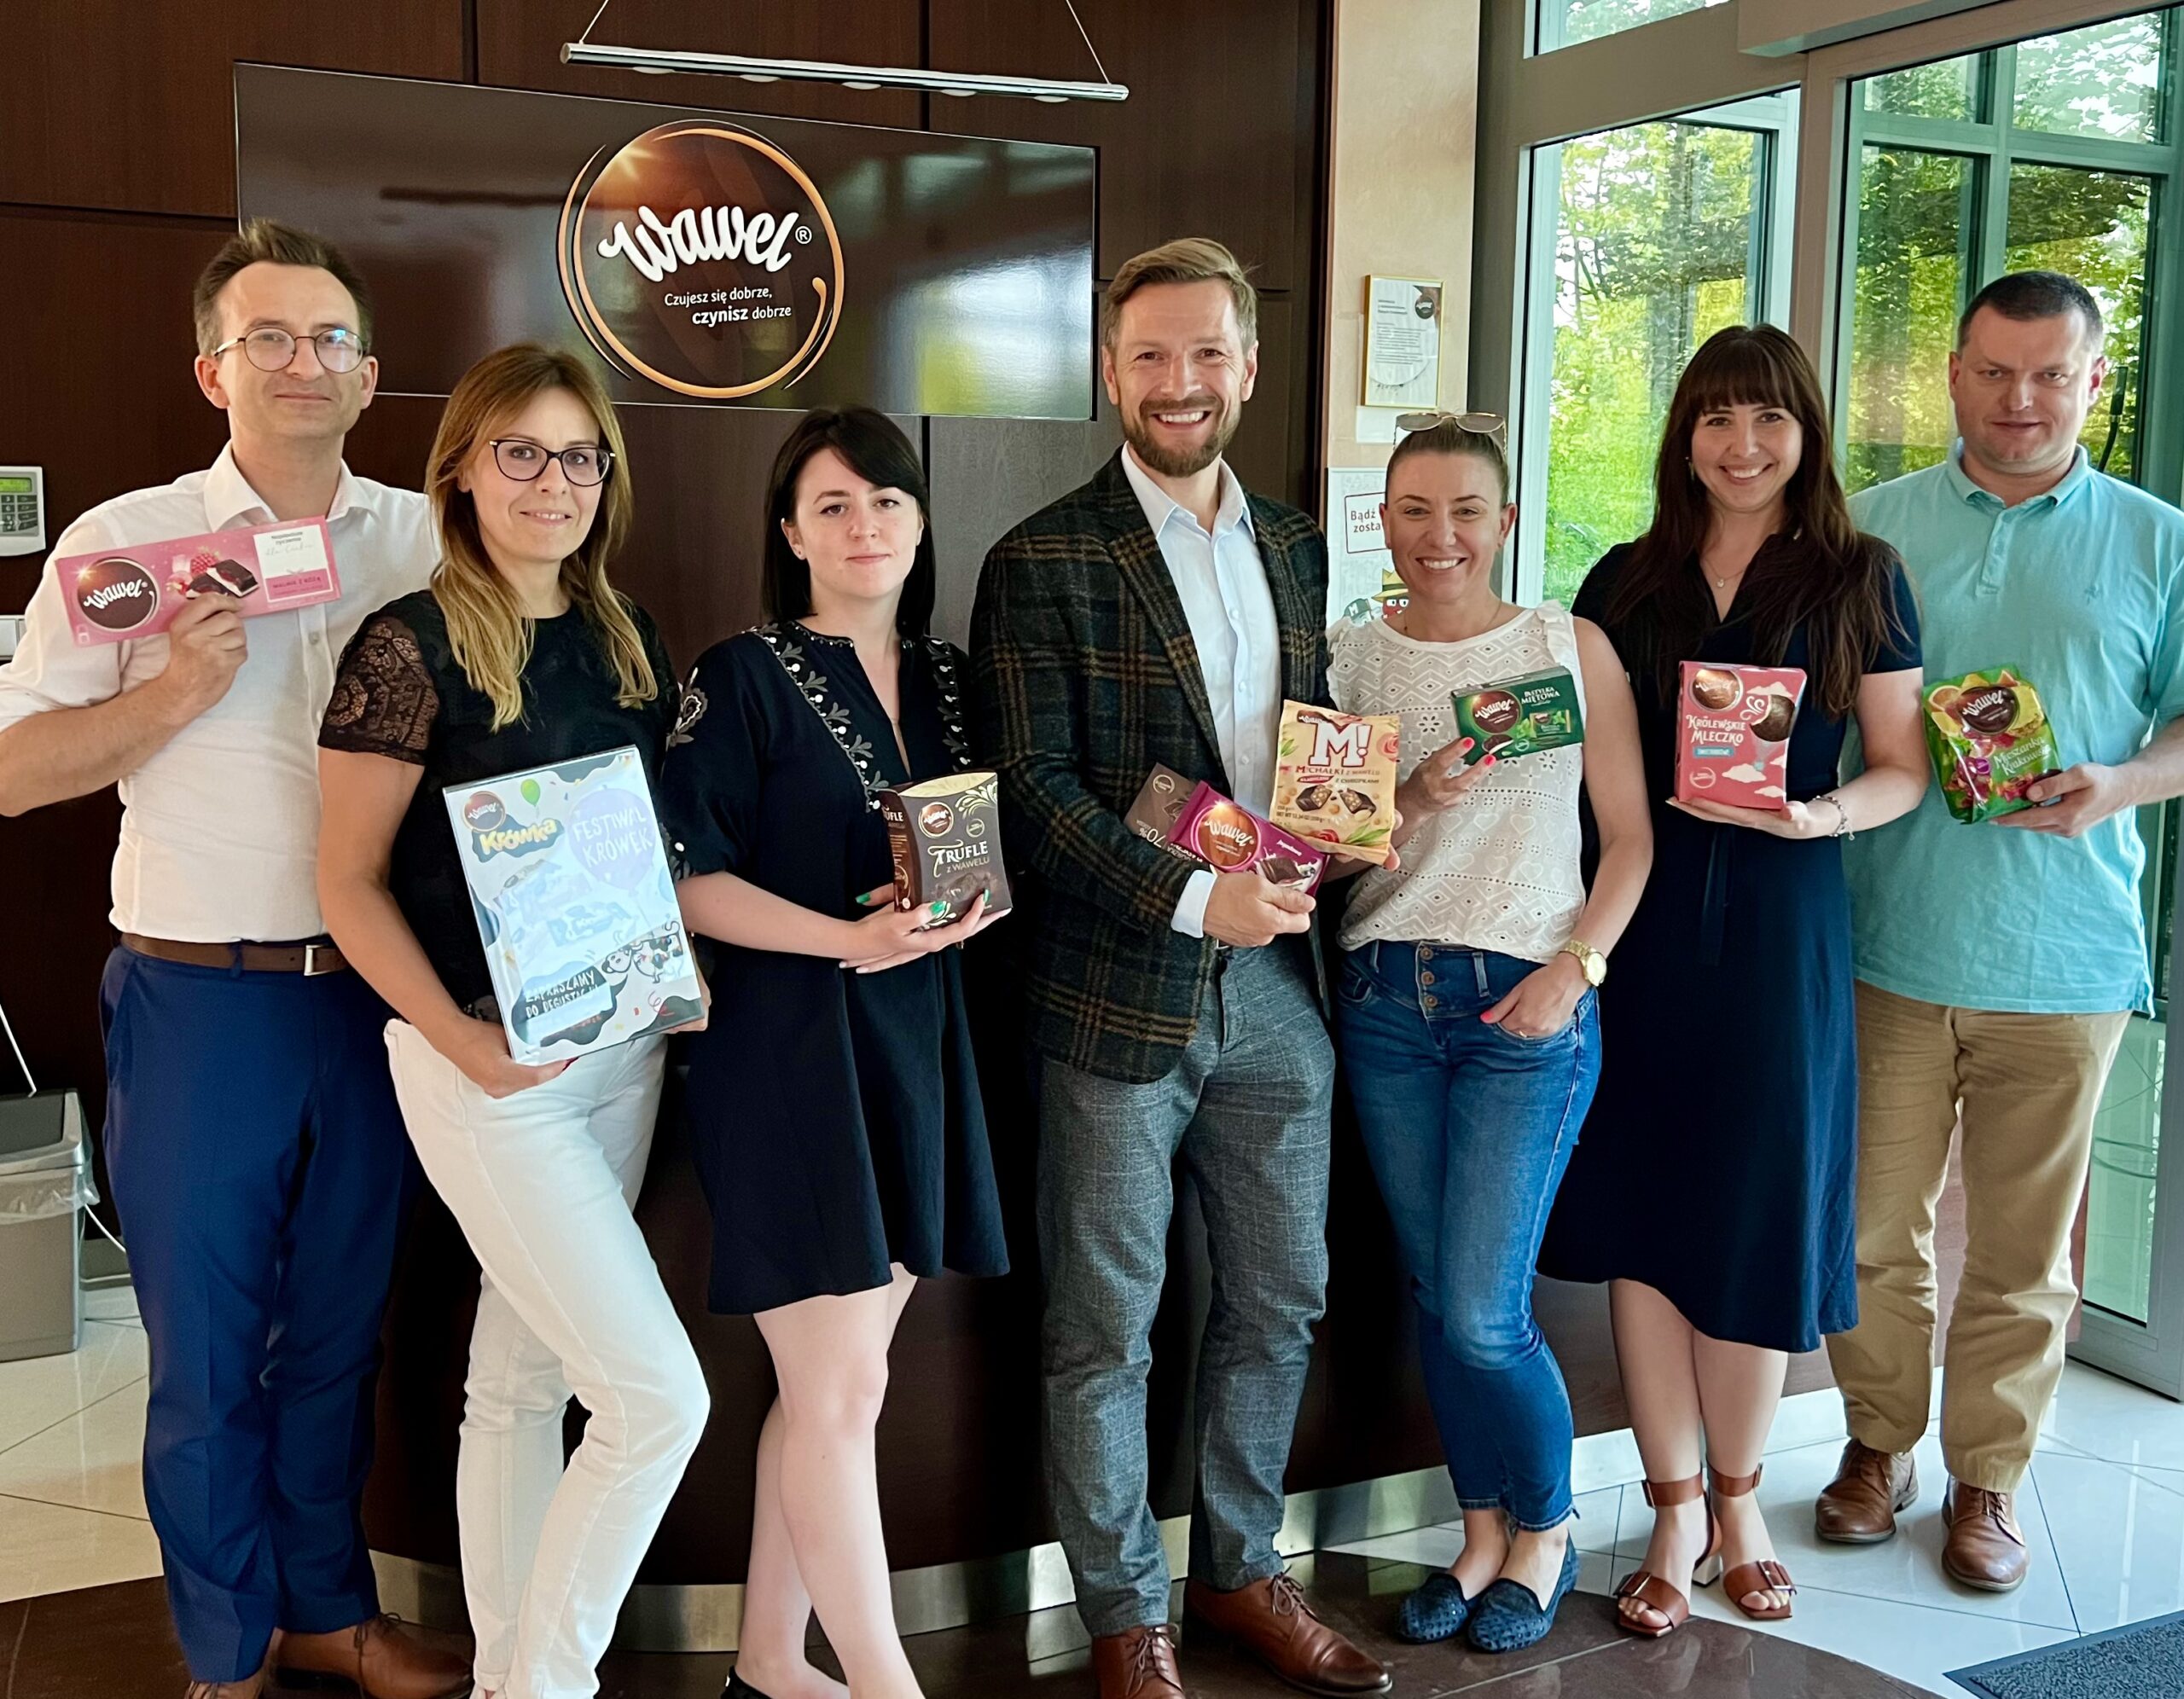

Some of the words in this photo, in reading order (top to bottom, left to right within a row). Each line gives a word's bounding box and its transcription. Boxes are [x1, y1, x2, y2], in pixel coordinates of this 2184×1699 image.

[597, 206, 799, 281] Wawel
[665, 292, 709, 308] Czujesz
[711, 288, 726, 304] się
[729, 286, 773, 300] dobrze,
[692, 305, 749, 328] czynisz
[752, 305, 793, 319] dobrze
[1353, 521, 1381, 533] zosta
[83, 578, 142, 609] Wawel
[1962, 690, 2004, 716] Wawel
[1690, 729, 1745, 746] MLECZKO
[572, 806, 647, 843] FESTIWAL
[1204, 820, 1253, 847] Wawel
[927, 839, 989, 878] TRUFLE
[952, 855, 990, 871] WAWELU
[526, 1004, 539, 1018] DO
